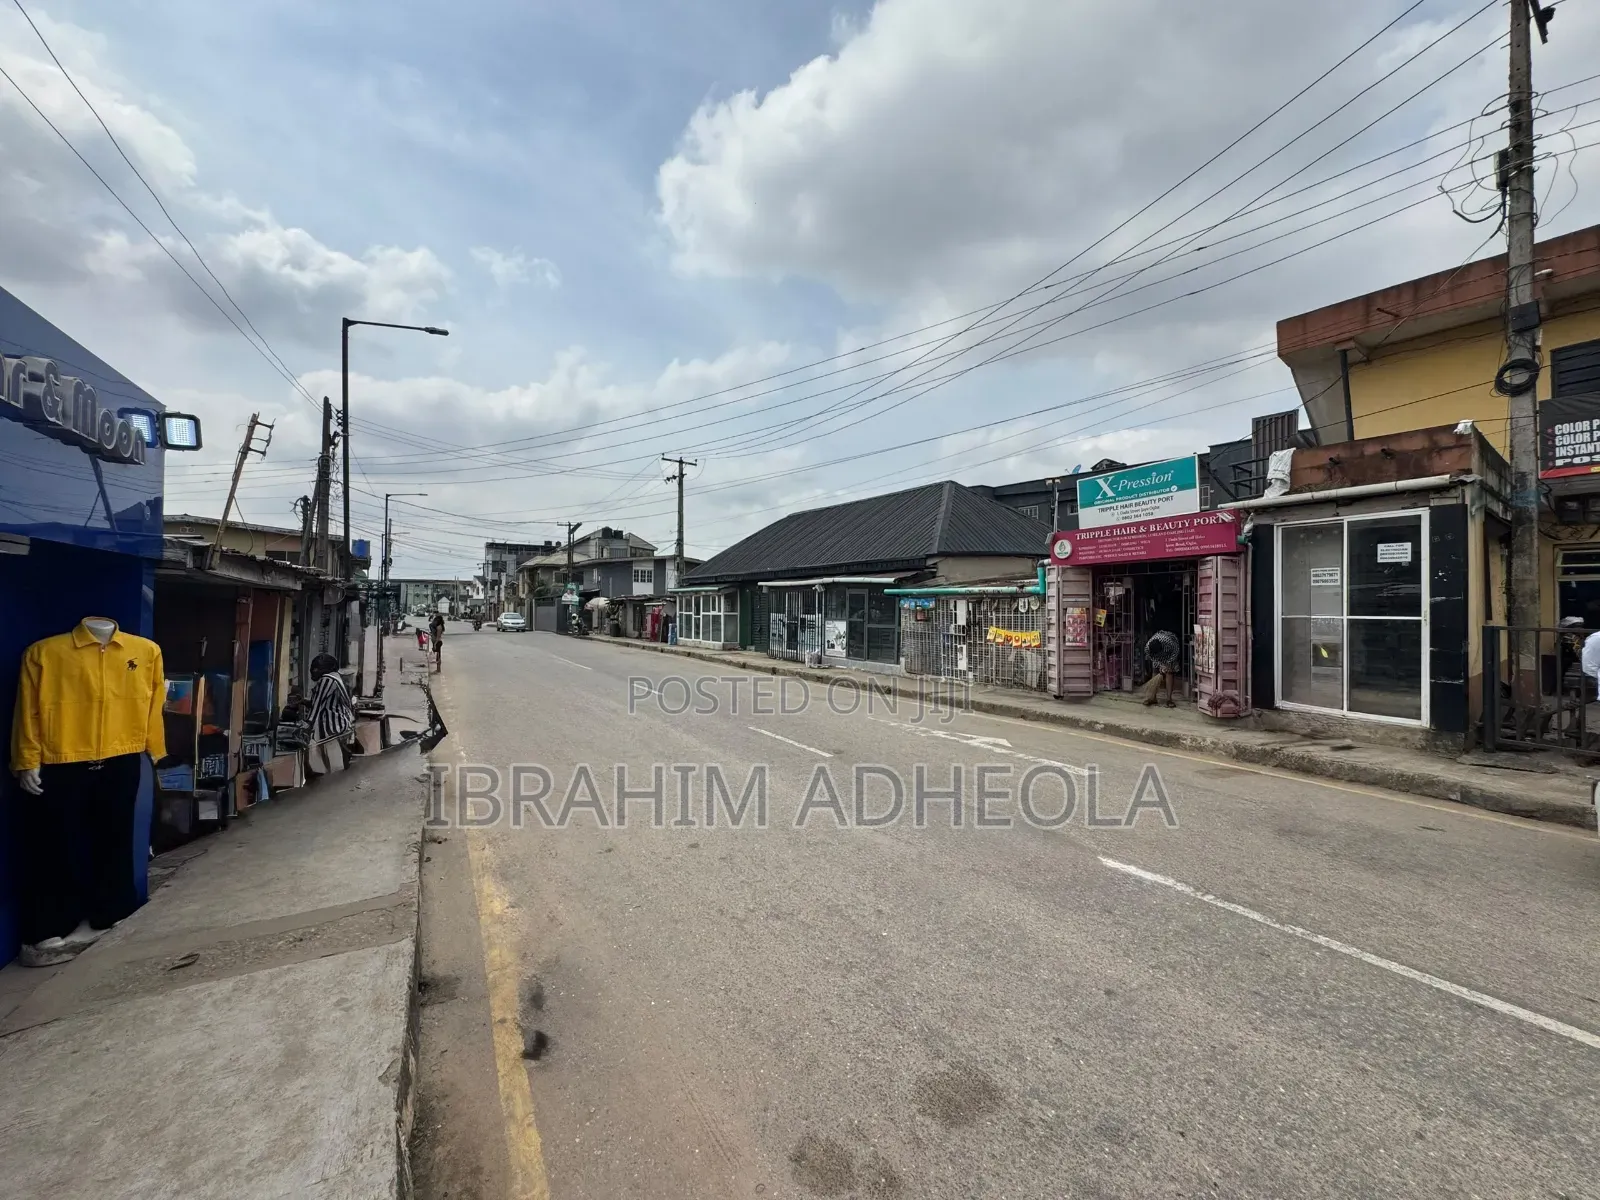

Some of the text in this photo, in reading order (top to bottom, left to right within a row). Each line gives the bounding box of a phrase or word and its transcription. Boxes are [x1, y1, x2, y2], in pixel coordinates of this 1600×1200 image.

[41, 360, 63, 427] &
[72, 379, 145, 465] Moon
[1555, 420, 1591, 435] COLOR
[1555, 432, 1591, 447] COLOR
[1555, 442, 1600, 458] INSTANT
[1095, 471, 1173, 500] X-Pression
[1139, 487, 1170, 497] DISTRIBUTOR
[1098, 495, 1174, 513] TRIPPLE HAIR BEAUTY PORT
[1075, 528, 1111, 540] TRIPPLE
[1113, 525, 1136, 536] HAIR
[1139, 525, 1147, 533] &
[1149, 519, 1191, 532] BEAUTY
